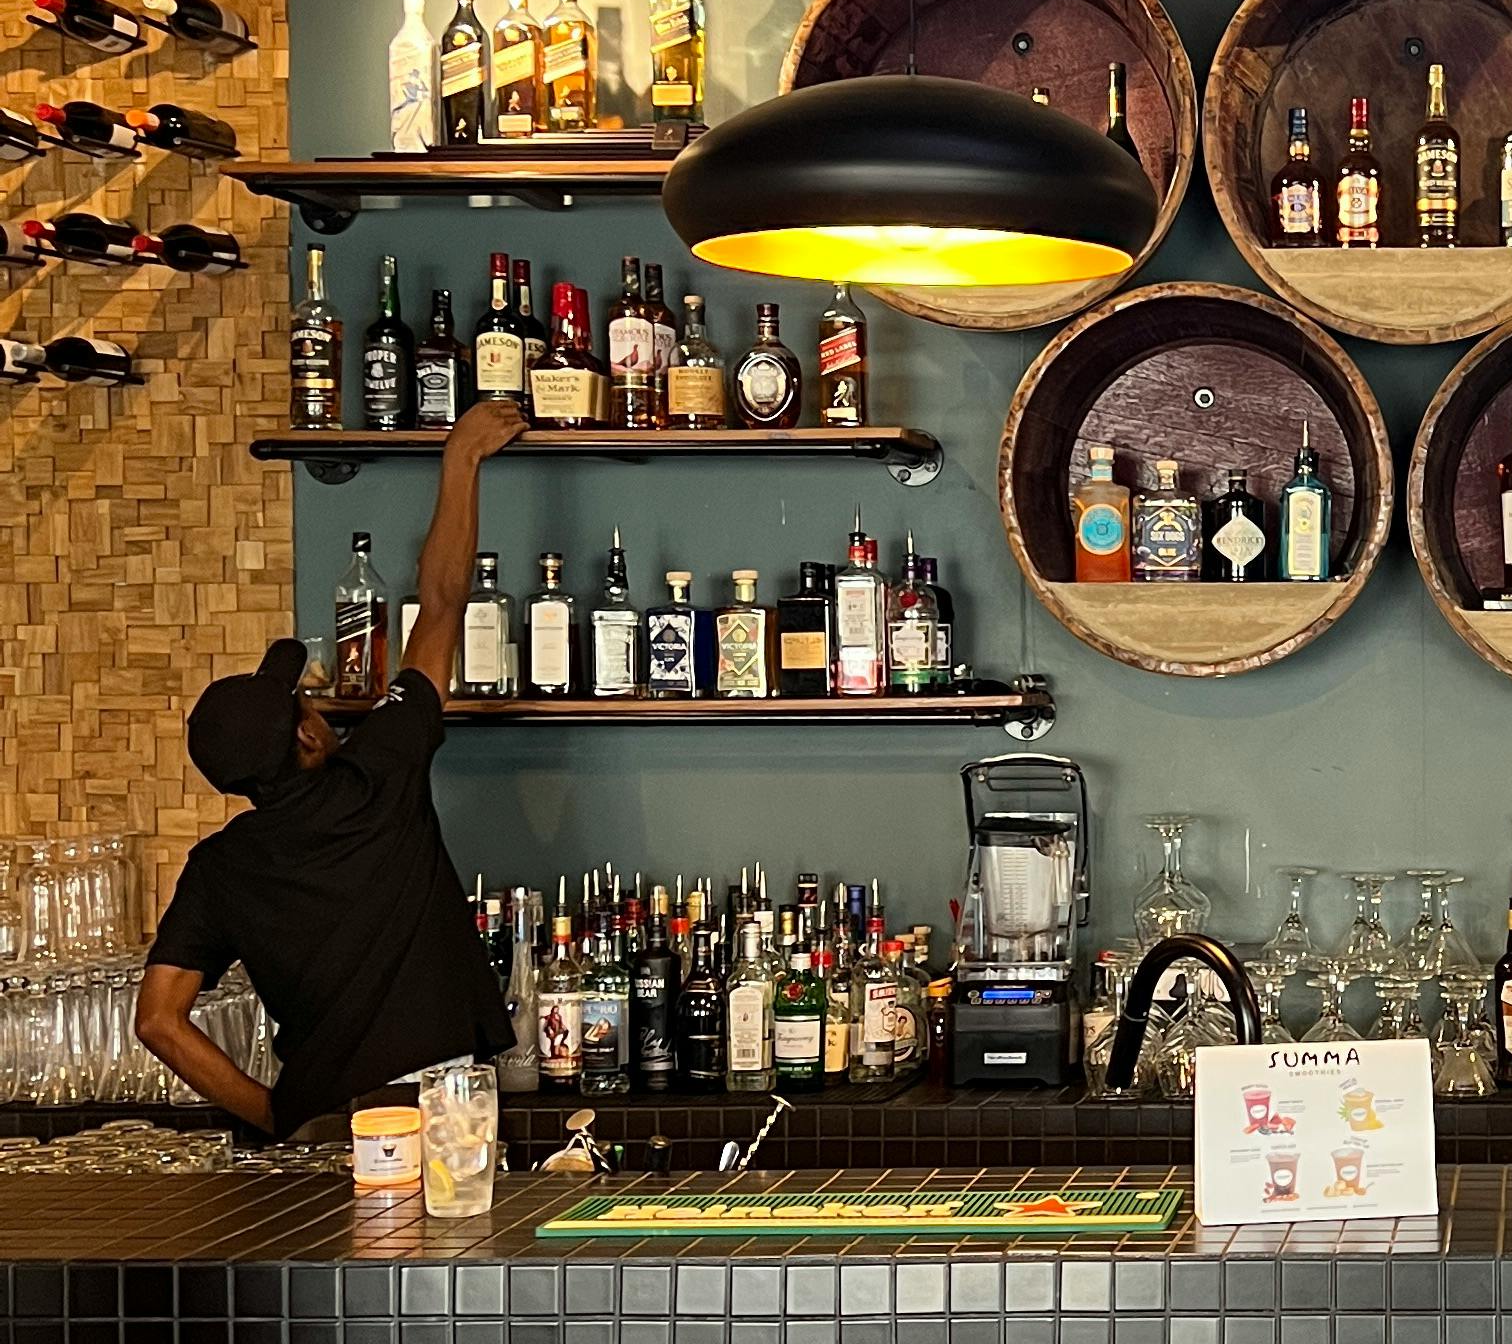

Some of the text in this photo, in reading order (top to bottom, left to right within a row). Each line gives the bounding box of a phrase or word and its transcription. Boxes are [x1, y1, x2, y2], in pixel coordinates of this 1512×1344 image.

[291, 329, 332, 343] JAMESON
[534, 374, 581, 383] Maker's
[546, 384, 581, 393] Mark
[651, 642, 686, 650] VICTORIA
[1268, 1047, 1361, 1069] SUMMA
[1288, 1068, 1342, 1078] SMOOTHIES
[598, 1200, 965, 1220] Heineken
